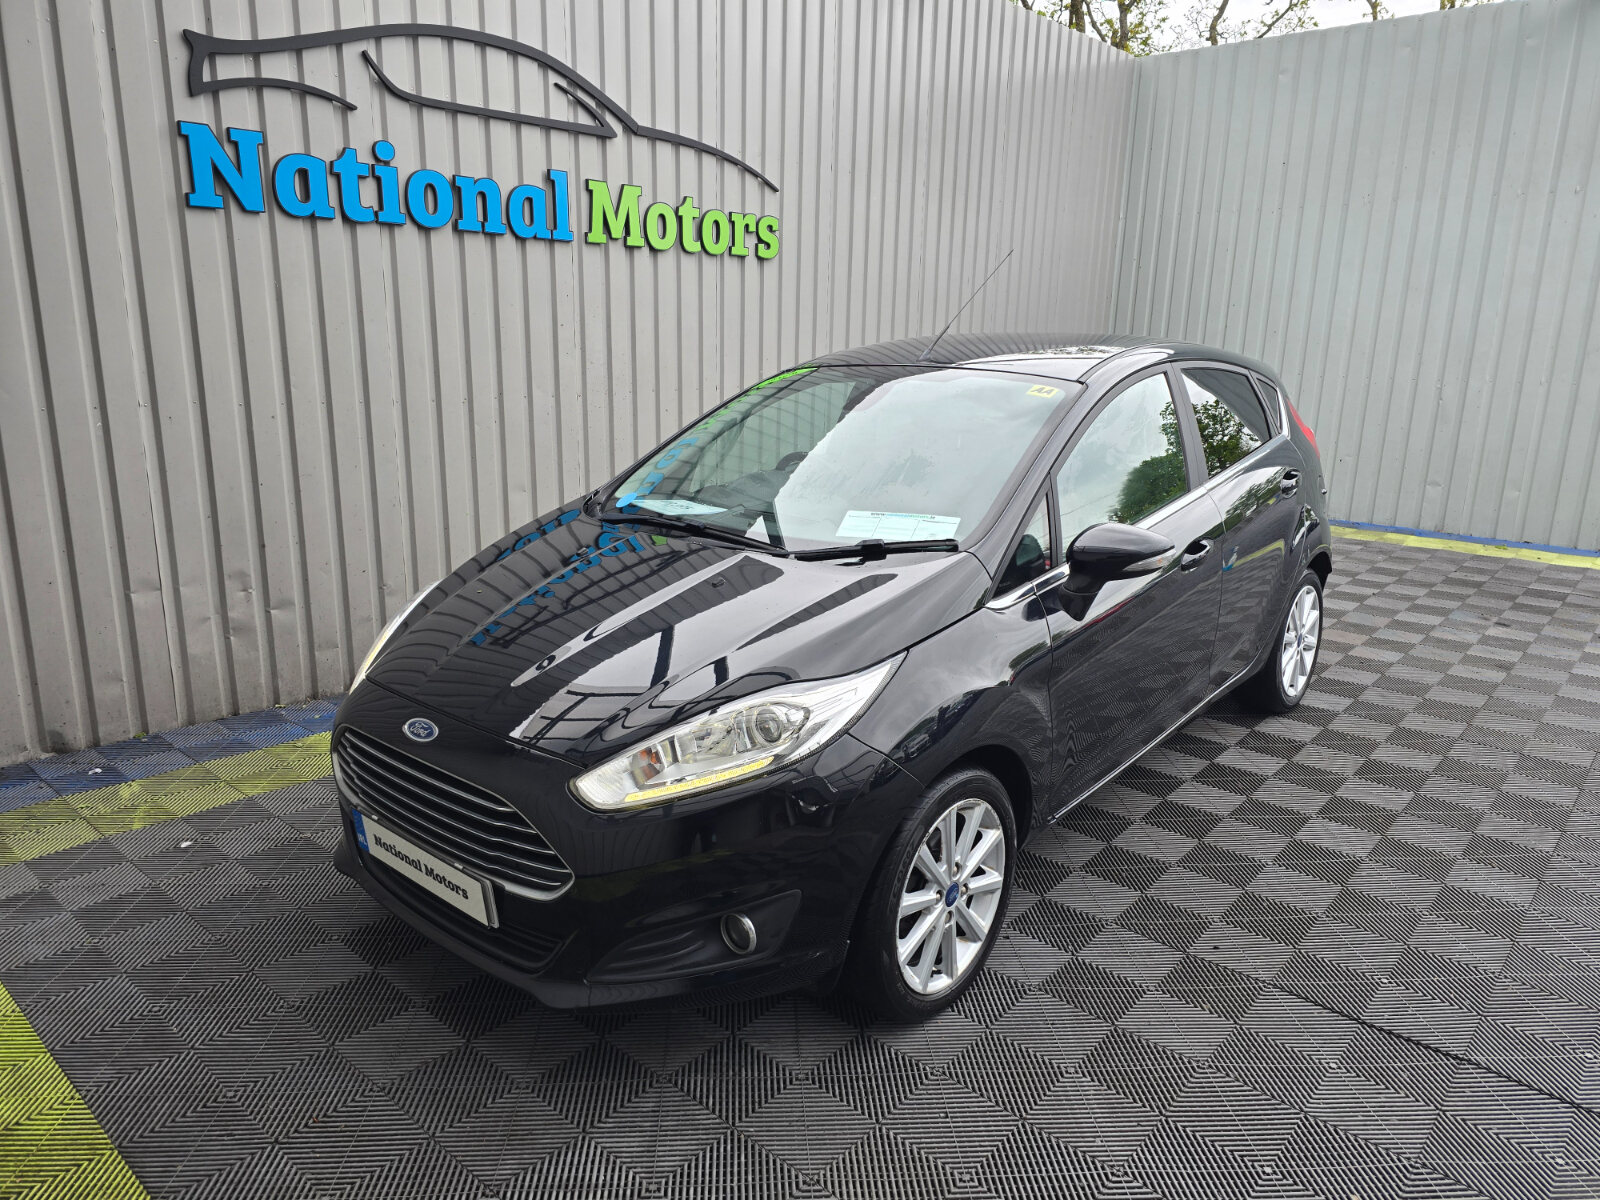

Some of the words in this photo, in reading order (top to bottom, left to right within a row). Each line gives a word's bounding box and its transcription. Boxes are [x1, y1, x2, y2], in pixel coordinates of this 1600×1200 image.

[178, 119, 574, 242] National
[585, 177, 780, 260] Motors
[410, 721, 431, 737] Ford
[373, 833, 423, 873] National
[423, 863, 469, 900] Motors
